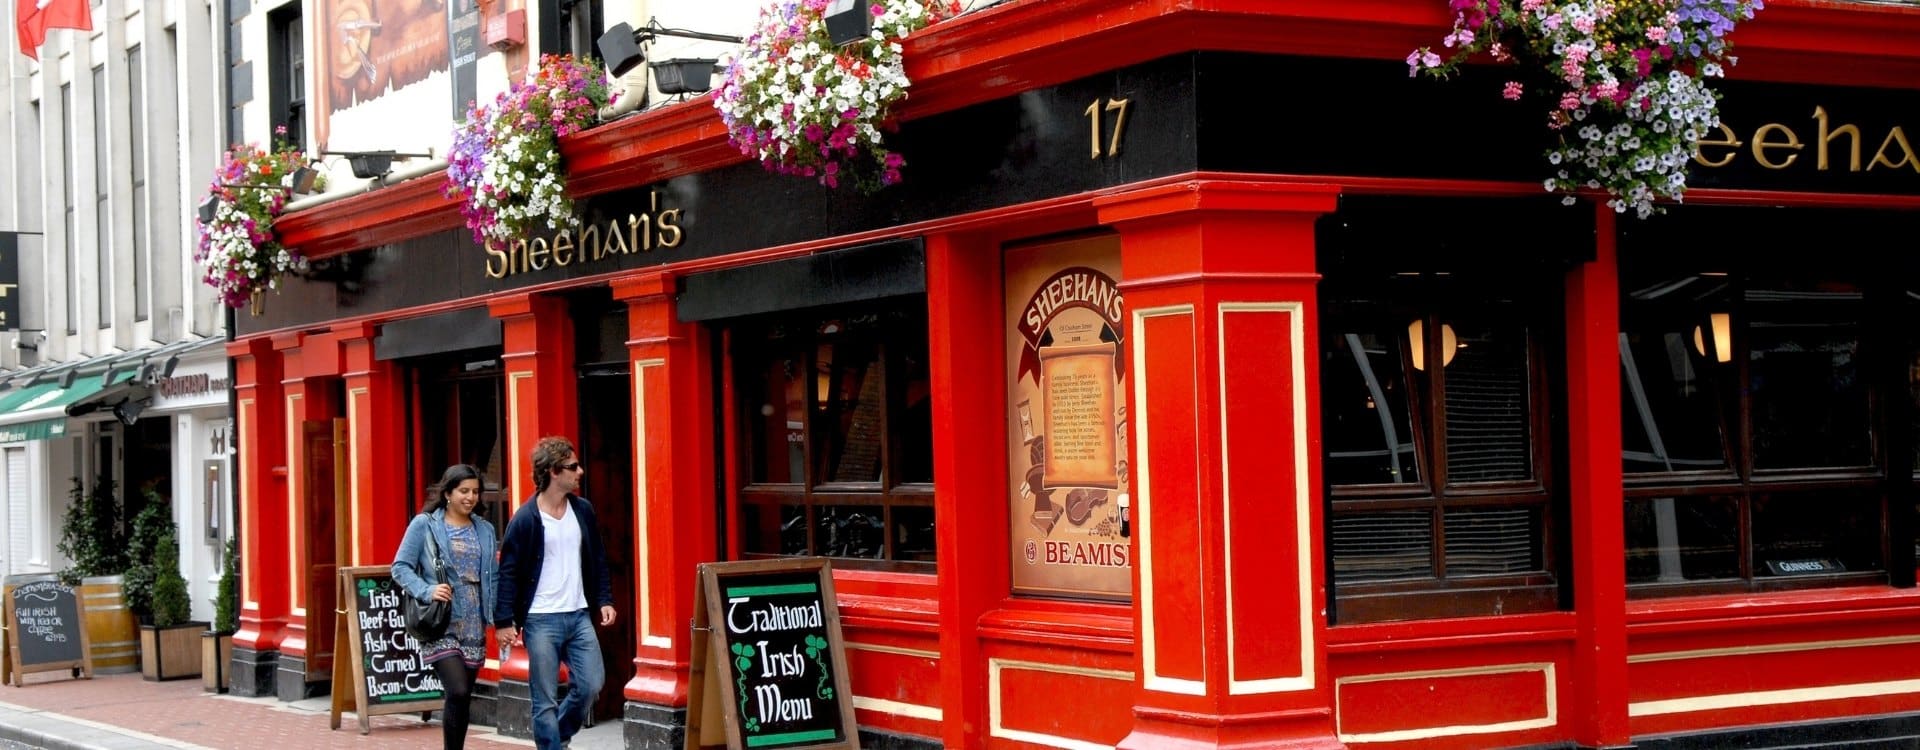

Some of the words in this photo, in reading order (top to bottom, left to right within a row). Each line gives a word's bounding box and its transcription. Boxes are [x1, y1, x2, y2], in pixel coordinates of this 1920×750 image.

[1084, 98, 1128, 159] 17
[1695, 105, 1920, 173] eeha
[484, 191, 682, 278] Sheehan's
[1026, 273, 1124, 335] SHEEHAN'S
[1779, 561, 1824, 572] GUINNESS
[368, 589, 399, 609] Irish
[727, 597, 822, 634] Traditional
[371, 654, 416, 673] Corned
[756, 640, 805, 678] Irish
[754, 683, 813, 724] Menu
